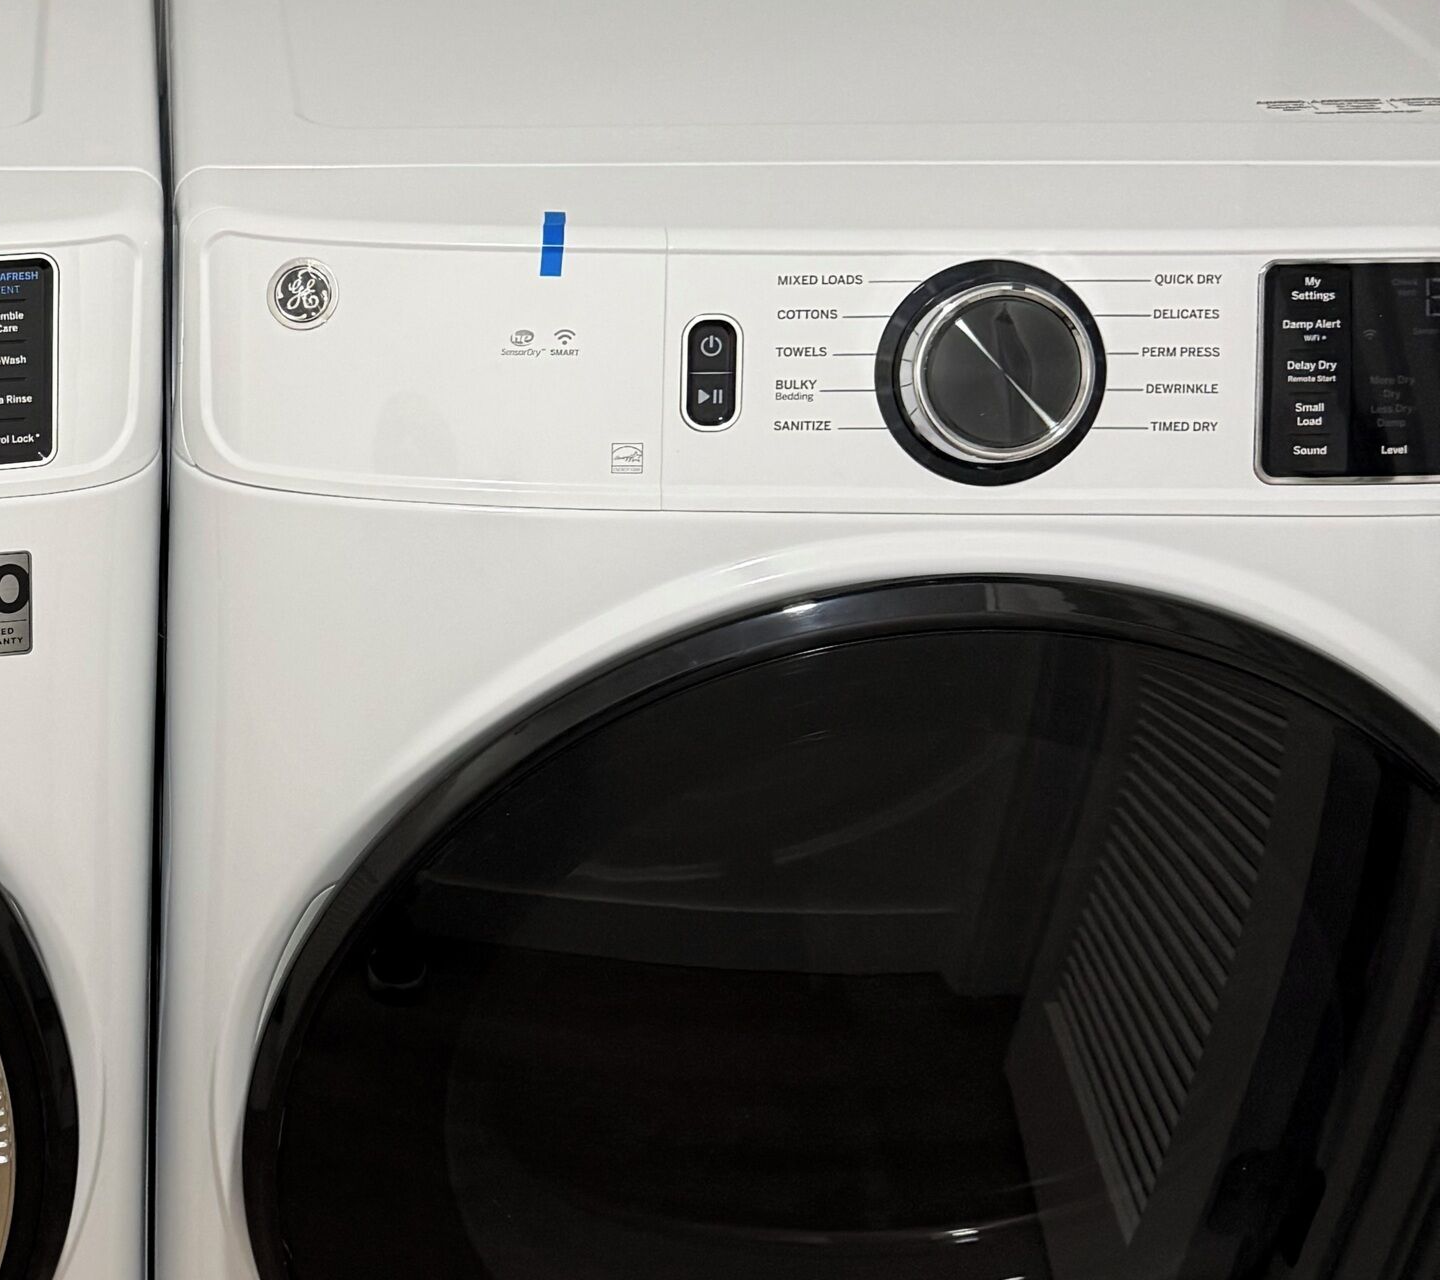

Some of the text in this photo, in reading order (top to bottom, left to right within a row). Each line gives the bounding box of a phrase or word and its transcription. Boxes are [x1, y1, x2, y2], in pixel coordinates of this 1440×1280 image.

[777, 274, 863, 285] MIXED LOADS
[1155, 274, 1222, 285] QUICK DRY
[1305, 277, 1322, 288] My
[1291, 291, 1336, 301] Settings
[777, 309, 838, 320] COTTONS
[1153, 309, 1220, 320] DELICATES
[1283, 320, 1341, 330] Damp Alert
[775, 347, 827, 358] TOWELS
[1142, 347, 1221, 358] PERM PRESS
[1287, 360, 1337, 372] Delay Dry
[775, 379, 817, 391] BULKY
[1146, 384, 1219, 394] DEWRINKLE
[6, 395, 32, 404] Rinse
[775, 391, 814, 403] Bedding
[1295, 403, 1325, 412] Small
[773, 421, 832, 432] SANITIZE
[1151, 422, 1218, 432] TIMED DRY
[1297, 417, 1322, 426] Load
[12, 434, 34, 443] Lock
[1293, 446, 1327, 455] Sound
[1381, 446, 1408, 454] Level
